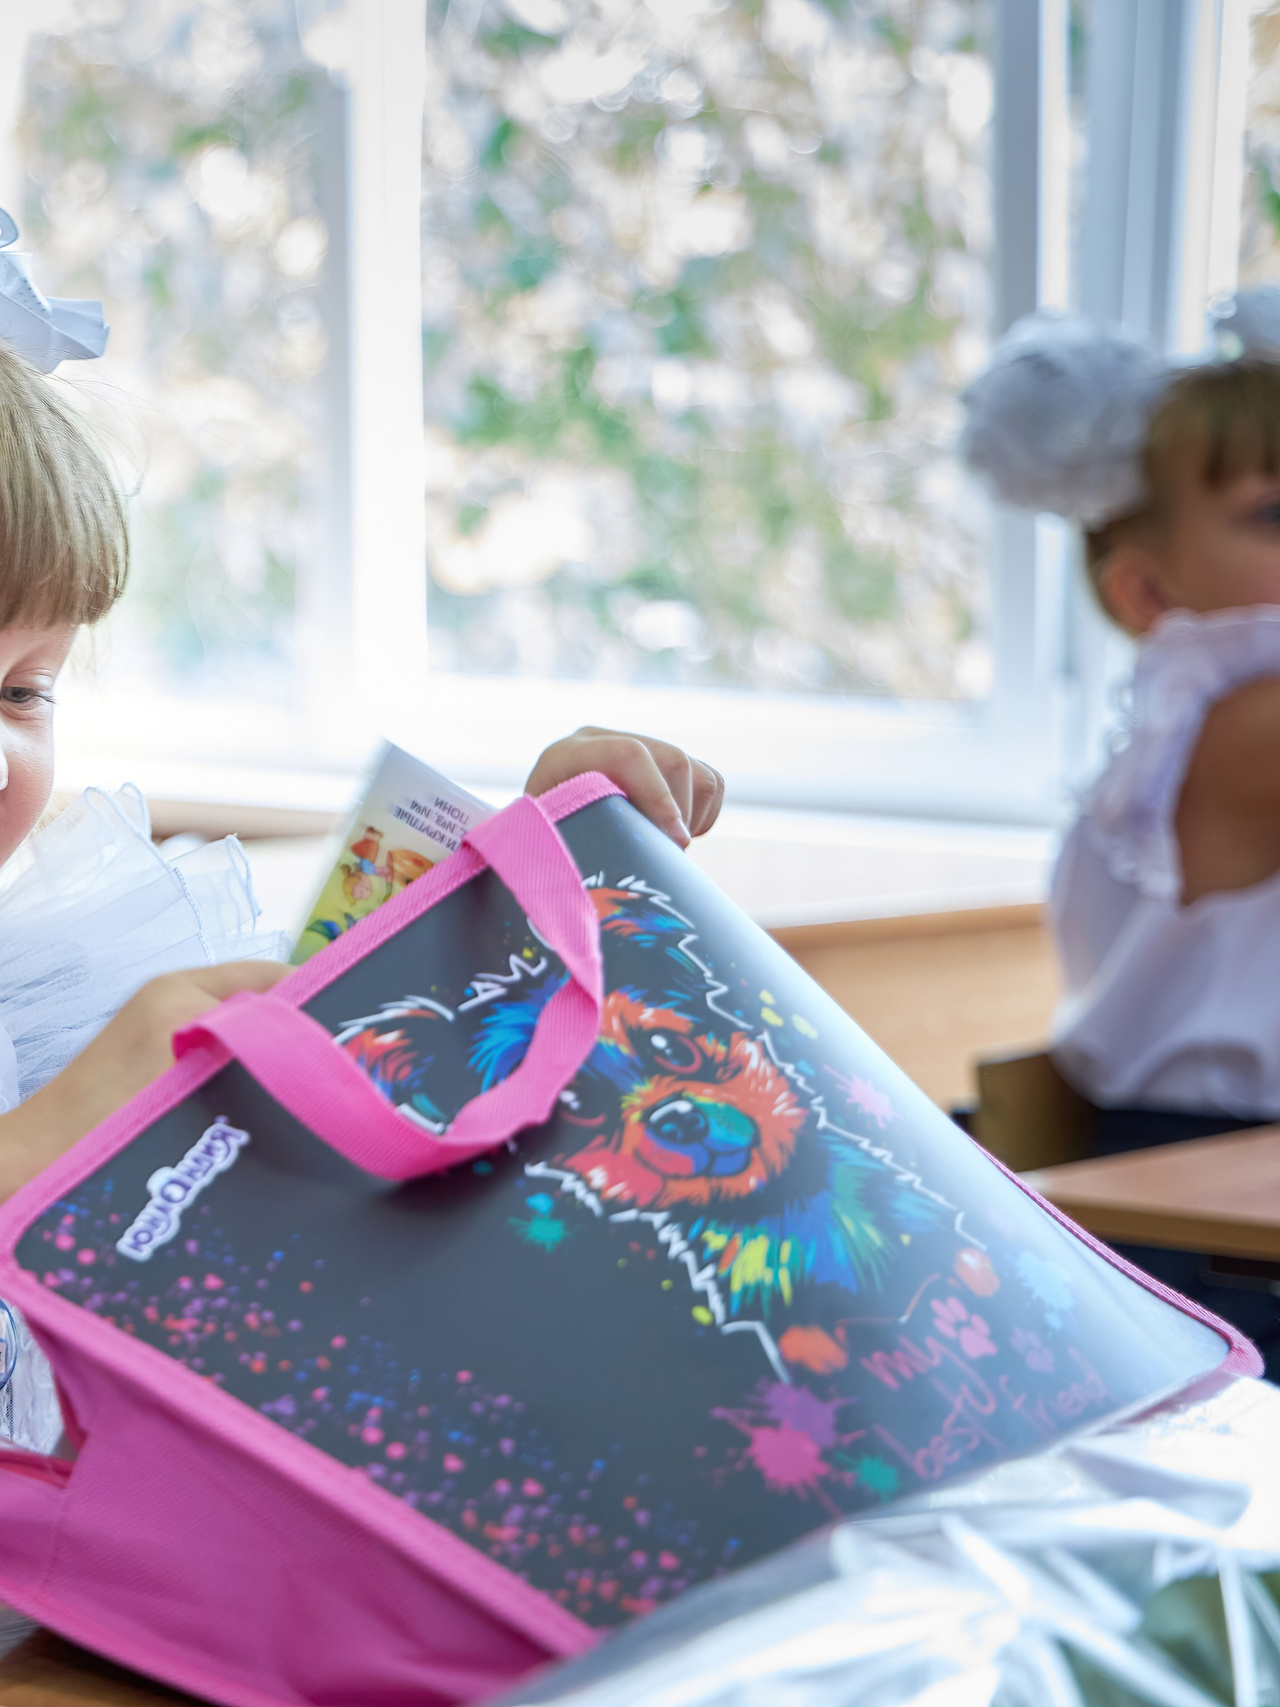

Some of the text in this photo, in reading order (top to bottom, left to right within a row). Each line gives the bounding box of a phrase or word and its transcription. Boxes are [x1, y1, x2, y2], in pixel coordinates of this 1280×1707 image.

[394, 807, 446, 843] КРУГЛЫЕ
[434, 797, 469, 825] ПОНИ
[860, 1334, 996, 1415] my
[873, 1375, 1007, 1479] best
